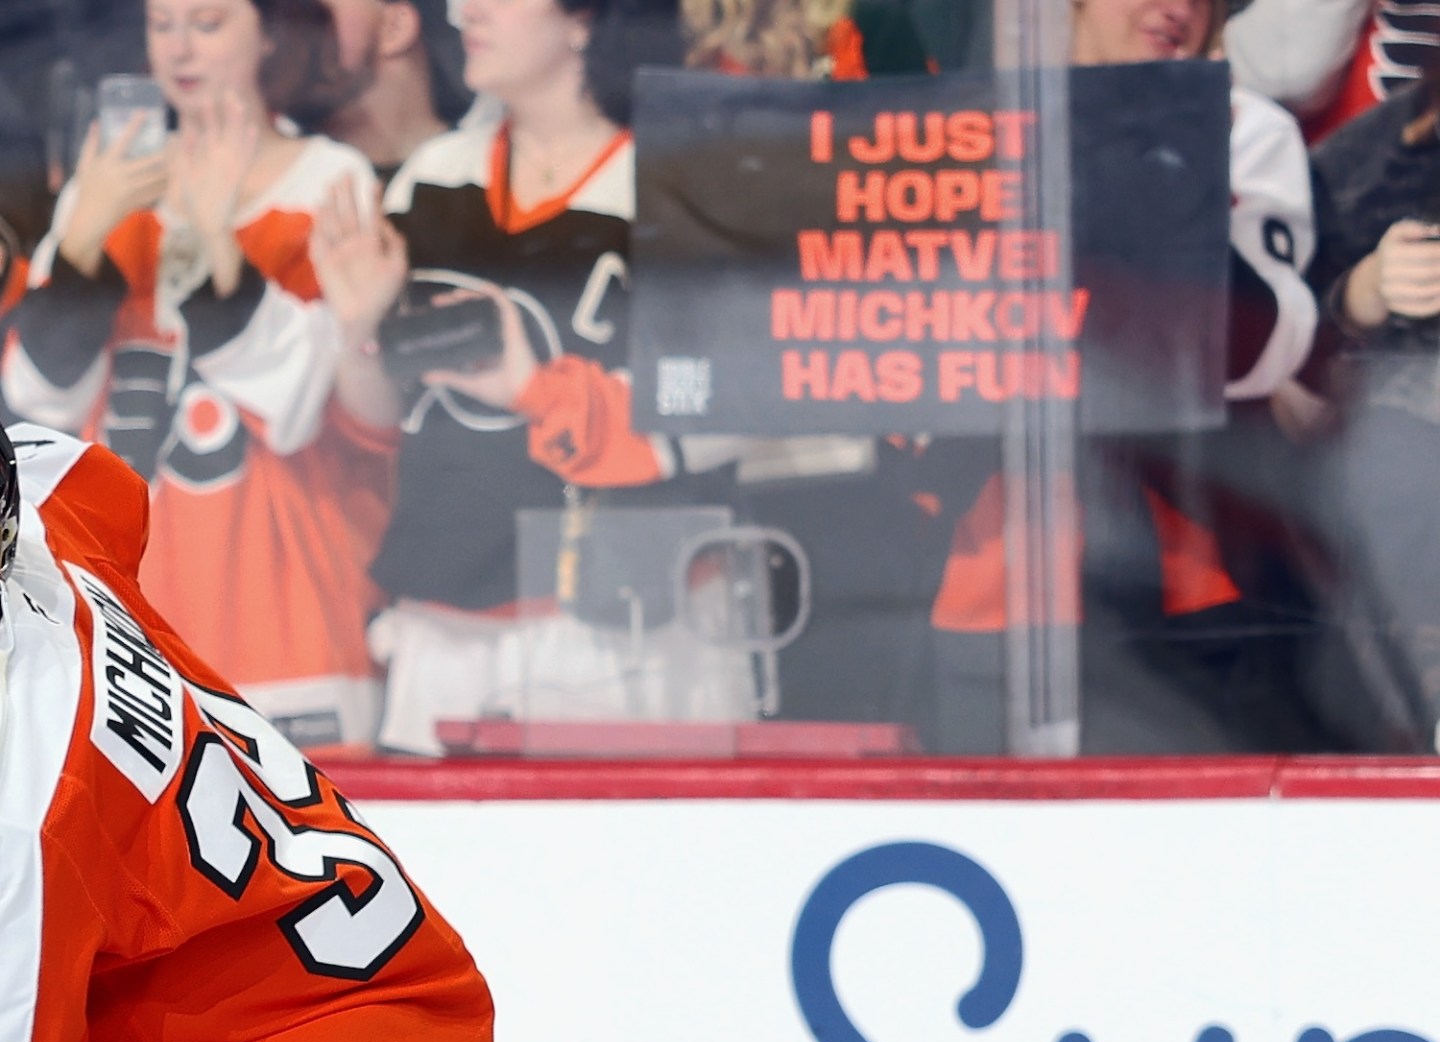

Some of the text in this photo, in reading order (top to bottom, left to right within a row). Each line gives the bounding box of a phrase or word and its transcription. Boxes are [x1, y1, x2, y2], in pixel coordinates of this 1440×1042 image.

[810, 110, 1037, 163] I JUST
[836, 169, 1028, 223] HOPE
[797, 229, 1059, 282] MATVEI
[771, 287, 1091, 342] MICHKOV
[782, 349, 1080, 403] HAS FUN
